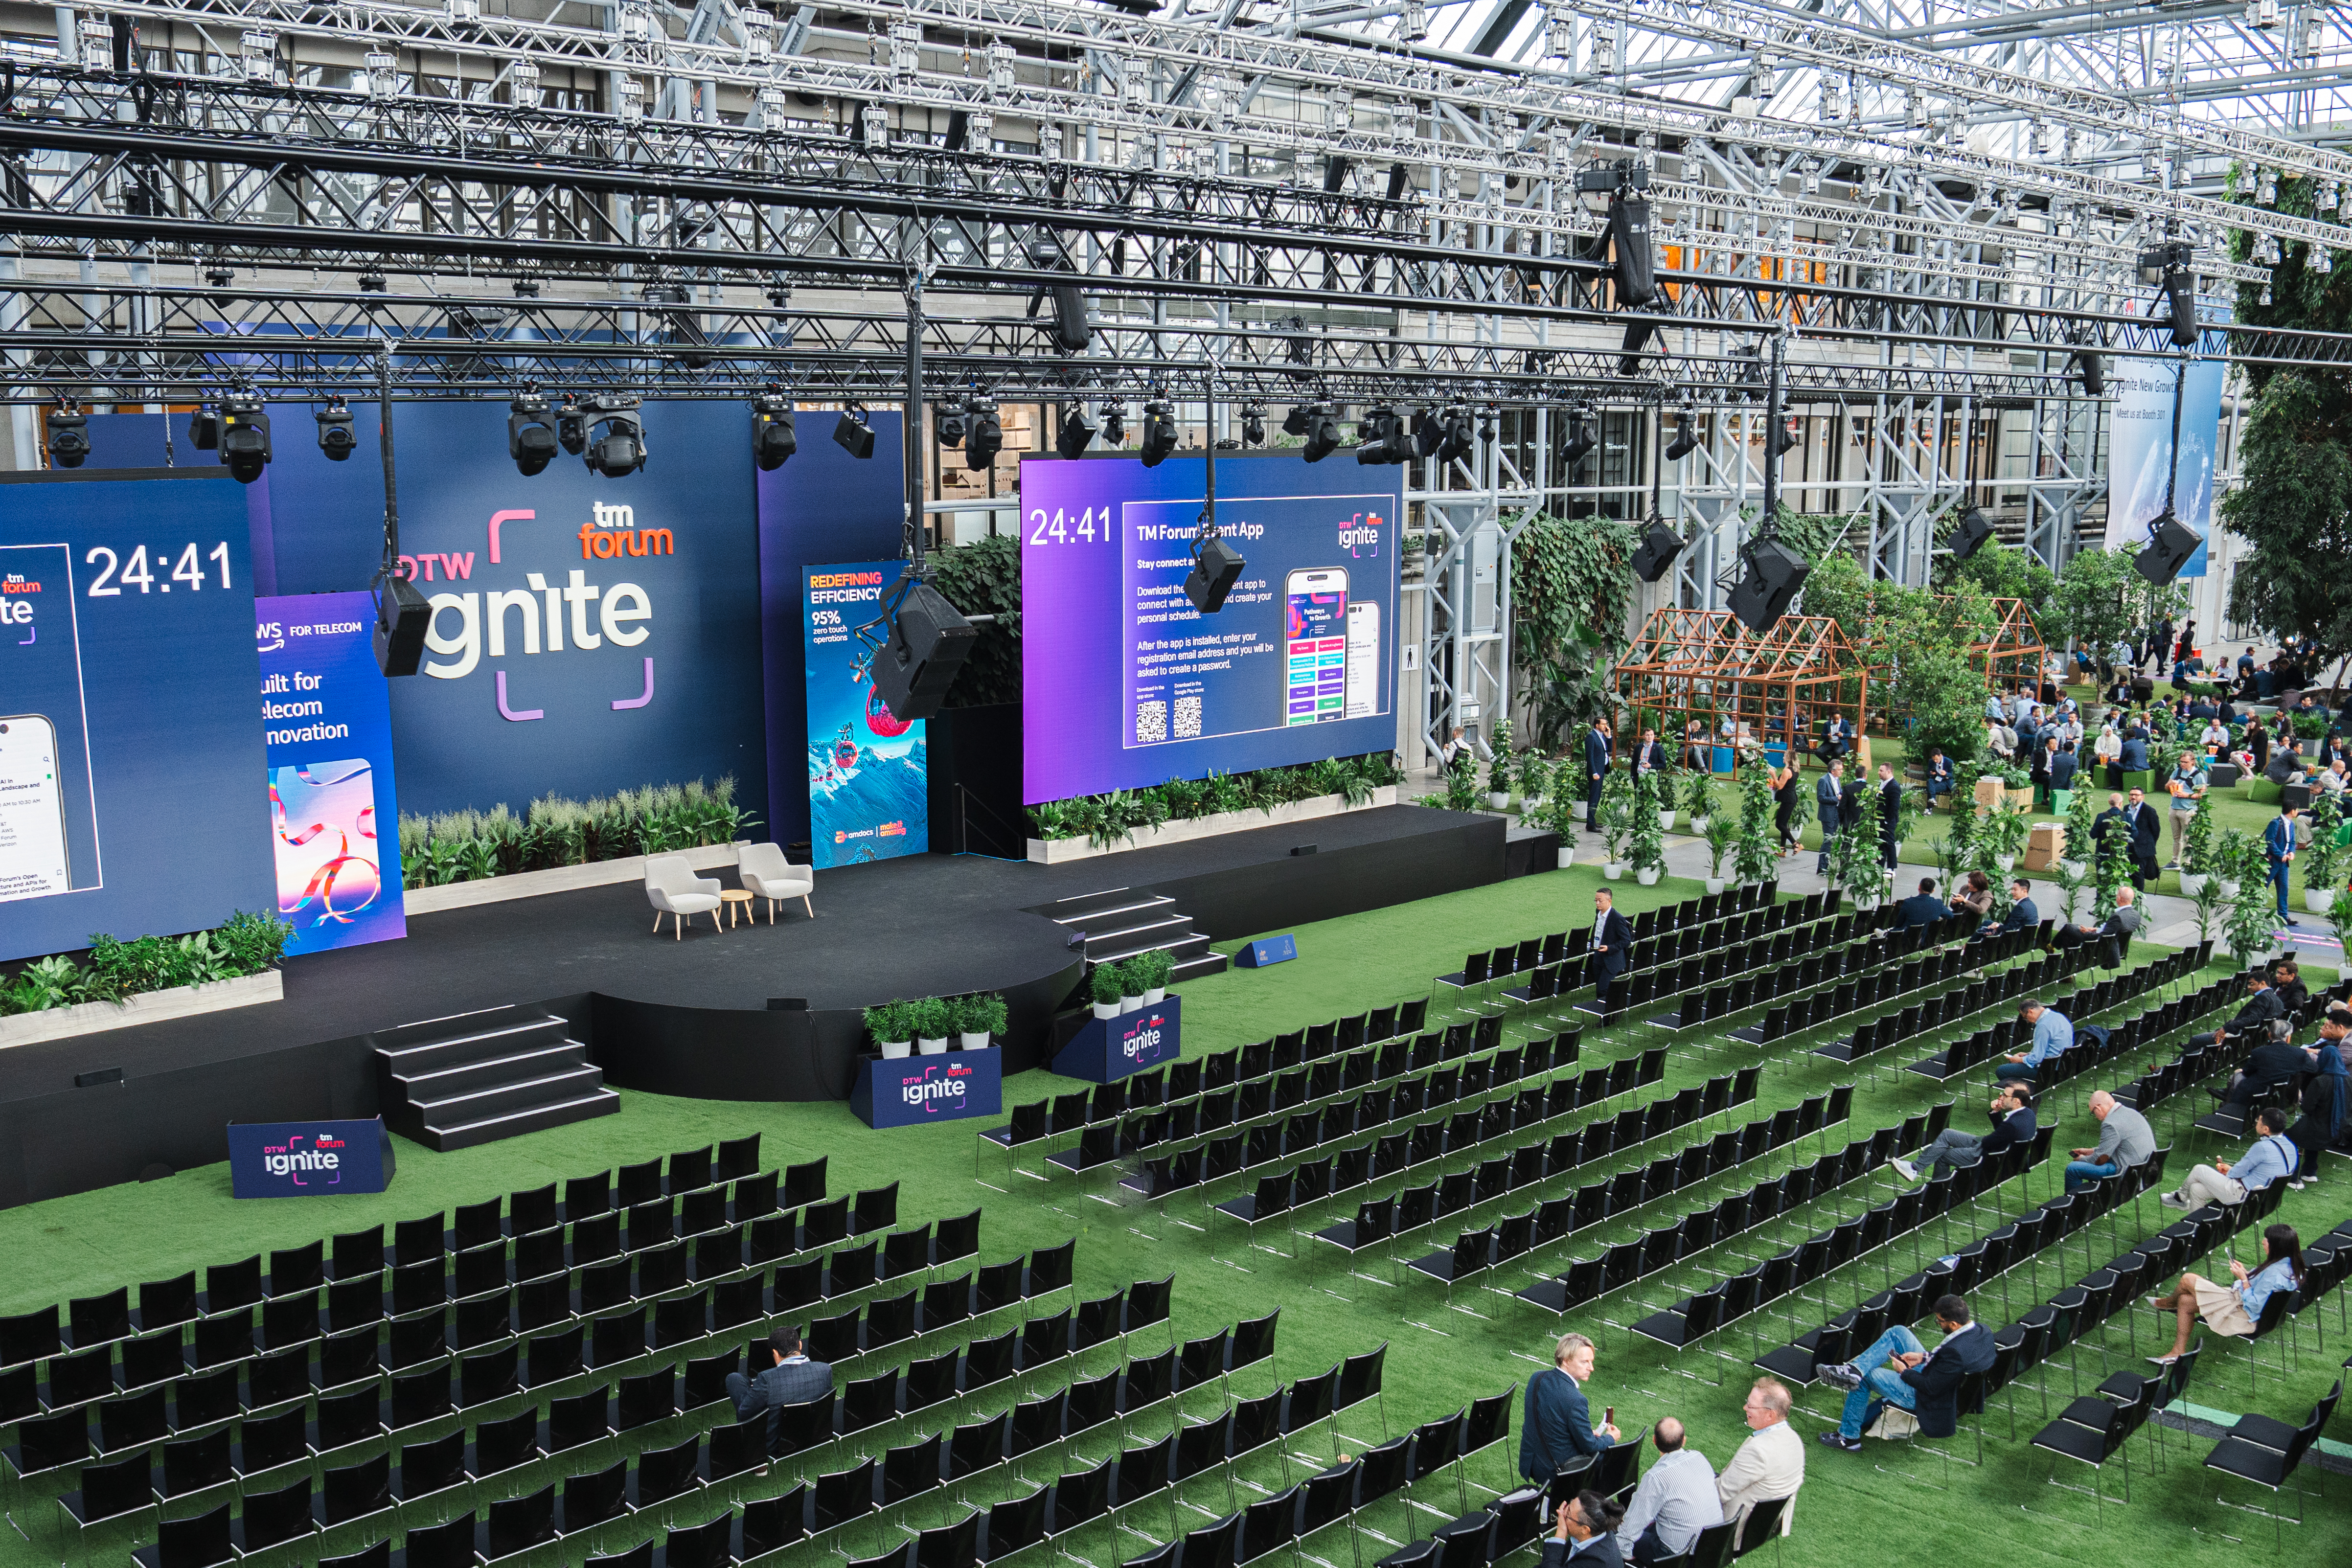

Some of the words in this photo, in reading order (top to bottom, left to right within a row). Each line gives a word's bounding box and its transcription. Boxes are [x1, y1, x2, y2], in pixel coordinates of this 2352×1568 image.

[2139, 379, 2153, 391] New
[2117, 408, 2128, 419] Meet
[2130, 410, 2135, 418] us
[2136, 410, 2141, 418] at
[2143, 409, 2156, 419] Booth
[2157, 410, 2165, 420] 301
[593, 501, 633, 527] tm
[1367, 516, 1383, 525] forum
[1029, 506, 1110, 545] 24:41
[1137, 525, 1157, 541] TM
[1160, 524, 1197, 540] Forum
[1238, 522, 1263, 540] App
[578, 523, 673, 559] forum
[1339, 526, 1378, 549] ignite
[86, 542, 231, 597] 24:41
[1137, 559, 1154, 570] Stay
[1156, 558, 1187, 568] connect
[2, 581, 41, 593] forum
[7, 573, 24, 584] tm
[810, 571, 882, 588] REDEFINING
[811, 587, 882, 604] EFFICIENCY
[1137, 585, 1171, 596] Download
[1173, 584, 1185, 594] the
[1245, 582, 1257, 591] app
[1259, 579, 1266, 588] to
[1137, 599, 1167, 610] connect
[1169, 598, 1184, 608] with
[1235, 593, 1256, 602] create
[1257, 592, 1272, 604] your
[424, 569, 652, 679] gnite
[812, 610, 841, 625] 95%
[1137, 613, 1167, 625] personal
[1169, 610, 1201, 621] schedule.
[290, 625, 312, 636] FOR
[313, 622, 362, 635] TELECOM
[829, 625, 847, 633] touch
[813, 635, 848, 645] operations
[1137, 641, 1155, 651] After
[1157, 640, 1168, 650] the
[1170, 640, 1184, 650] app
[1185, 637, 1191, 646] is
[1193, 635, 1222, 646] installed,
[1223, 634, 1241, 643] enter
[1242, 633, 1257, 643] your
[1137, 653, 1176, 666] registration
[1178, 650, 1196, 660] email
[1198, 648, 1224, 659] address
[1226, 646, 1239, 656] and
[1240, 646, 1253, 657] you
[1254, 643, 1264, 653] will
[1265, 642, 1274, 652] be
[1137, 666, 1158, 678] asked
[1160, 666, 1167, 675] to
[1169, 664, 1191, 675] create
[1198, 659, 1232, 673] password.
[294, 672, 322, 691] for
[848, 830, 873, 839] amdocs
[880, 821, 897, 831] make
[880, 827, 906, 837] amazing
[1150, 1018, 1164, 1027] forum
[1124, 1030, 1136, 1039] DTW
[1124, 1029, 1160, 1057] ignite
[947, 1068, 972, 1076] forum
[903, 1078, 965, 1104] ignite
[316, 1139, 344, 1148] forum
[265, 1150, 339, 1175] ignite
